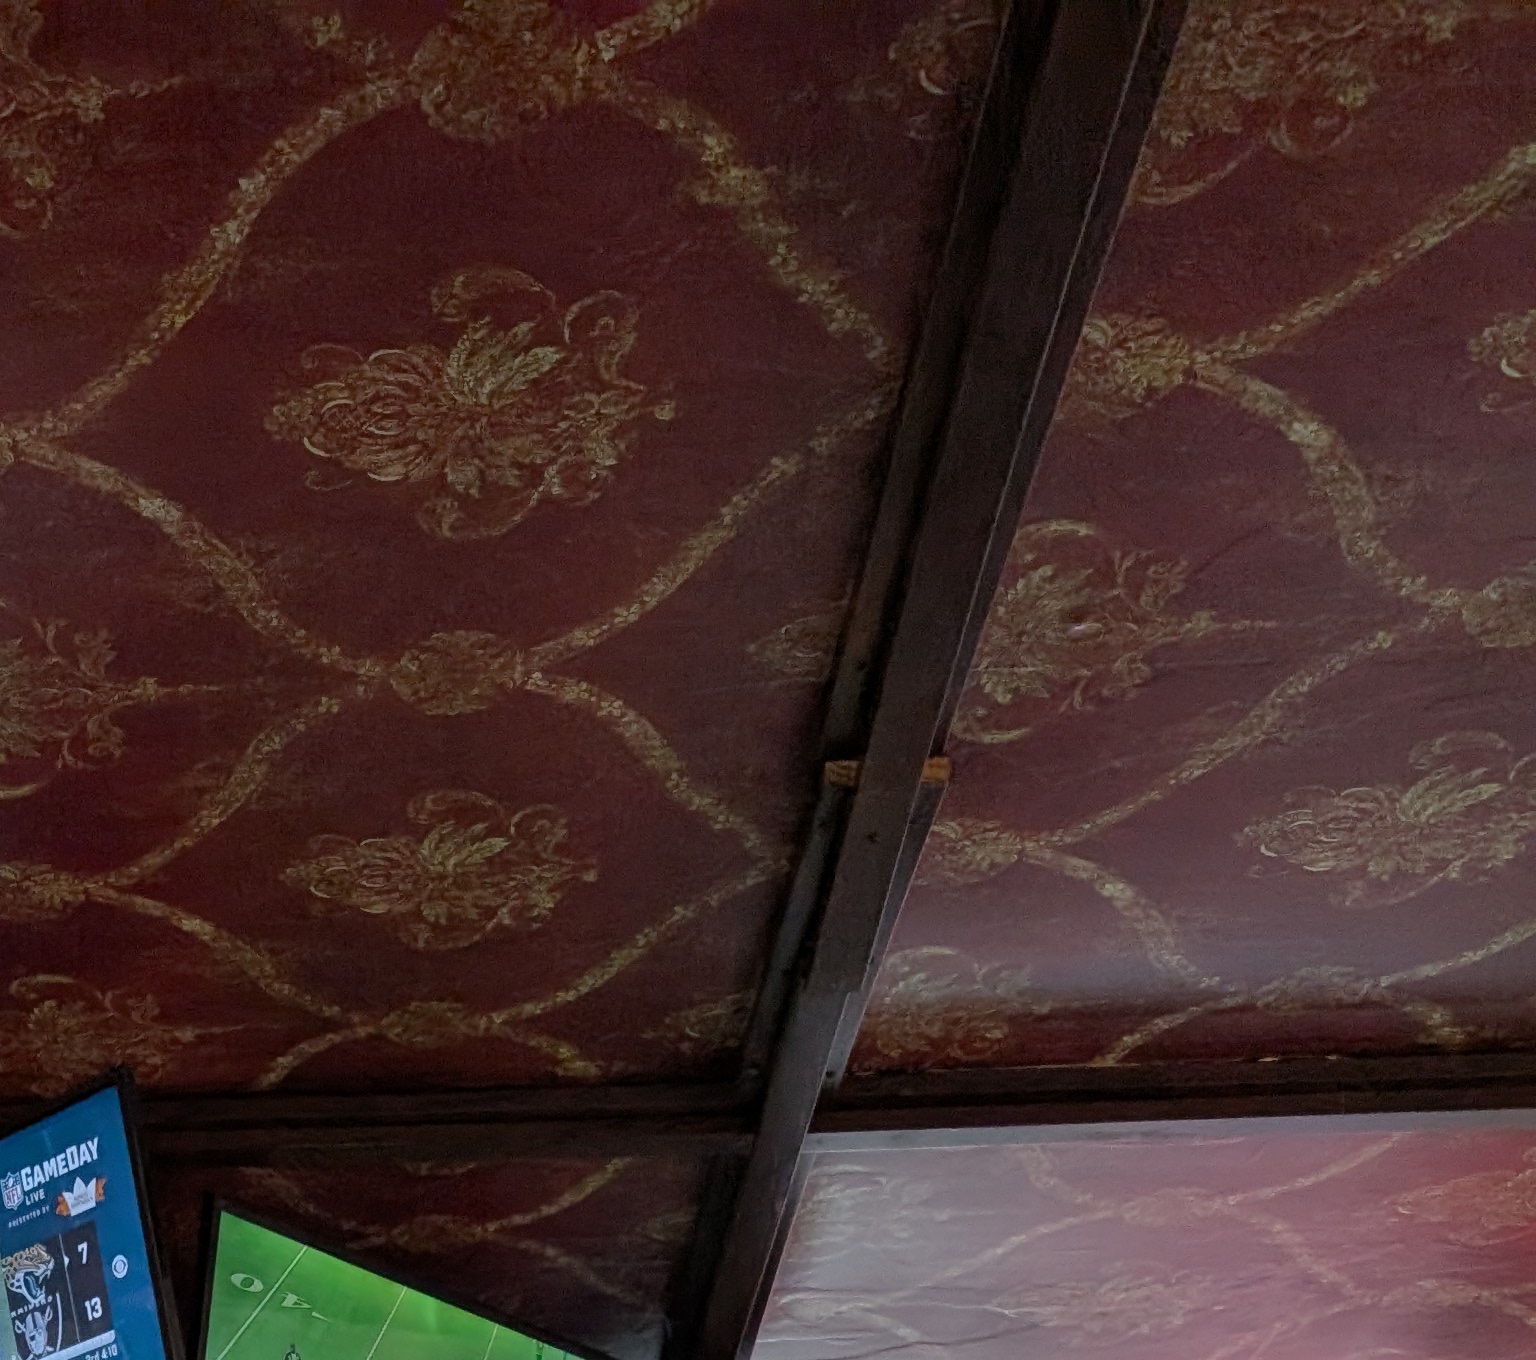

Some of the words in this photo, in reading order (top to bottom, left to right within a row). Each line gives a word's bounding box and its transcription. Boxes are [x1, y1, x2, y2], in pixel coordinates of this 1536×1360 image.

[21, 1137, 98, 1191] GAMEDAY
[25, 1189, 45, 1206] LIVE
[77, 1242, 89, 1265] 7
[85, 1297, 102, 1321] 13
